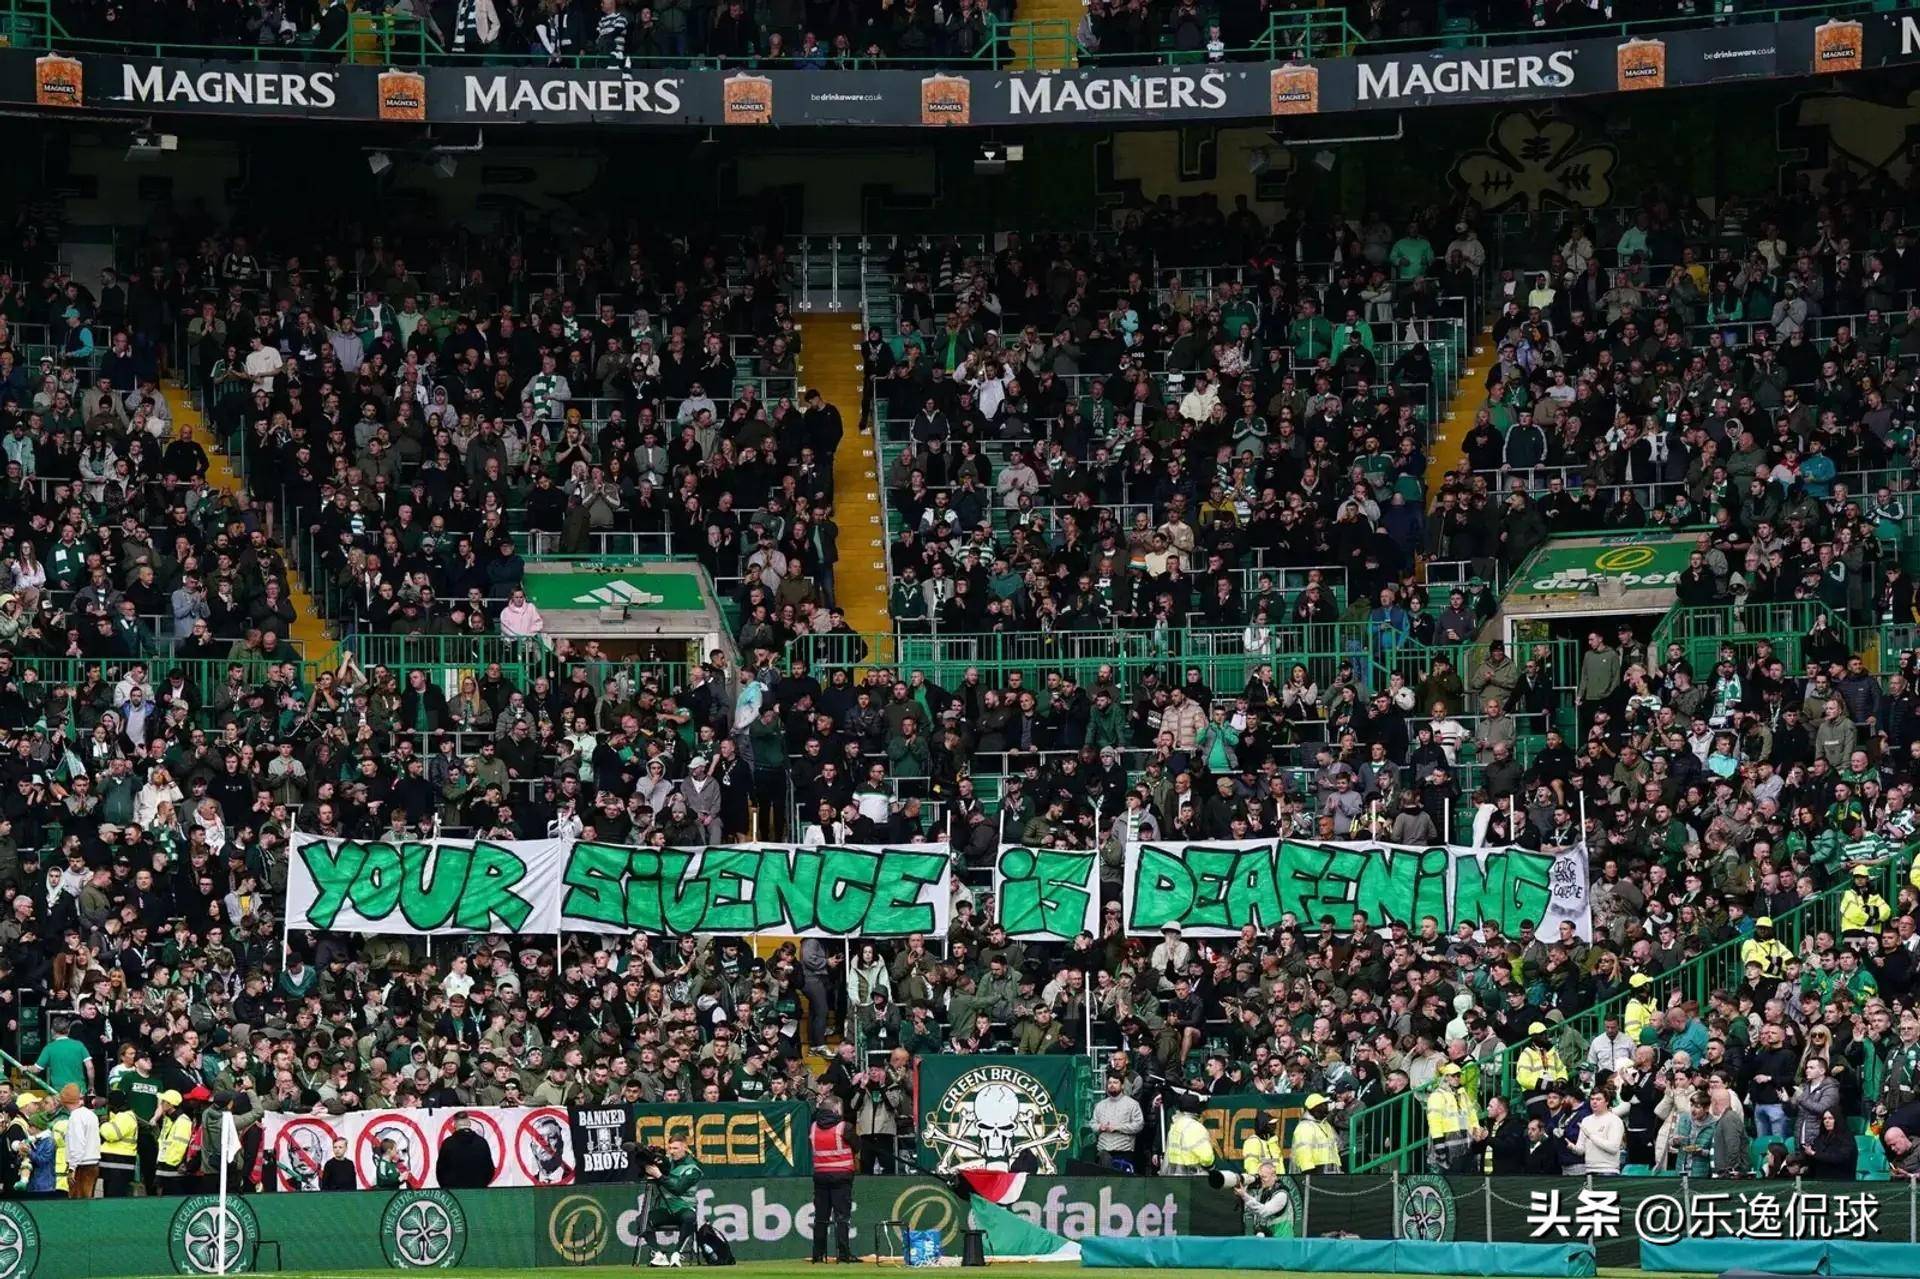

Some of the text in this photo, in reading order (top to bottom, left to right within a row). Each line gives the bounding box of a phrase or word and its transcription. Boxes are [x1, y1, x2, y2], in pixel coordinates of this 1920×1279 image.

[122, 64, 336, 108] MAGNERS
[464, 75, 681, 115] MAGNERS
[1009, 73, 1227, 114] MAGNERS
[1357, 51, 1575, 100] MAGNERS
[298, 839, 533, 932] YOUR
[942, 1068, 1054, 1114] GREEN BRIGADE
[578, 1109, 626, 1127] BANNED
[583, 1151, 629, 1173] BHOYS
